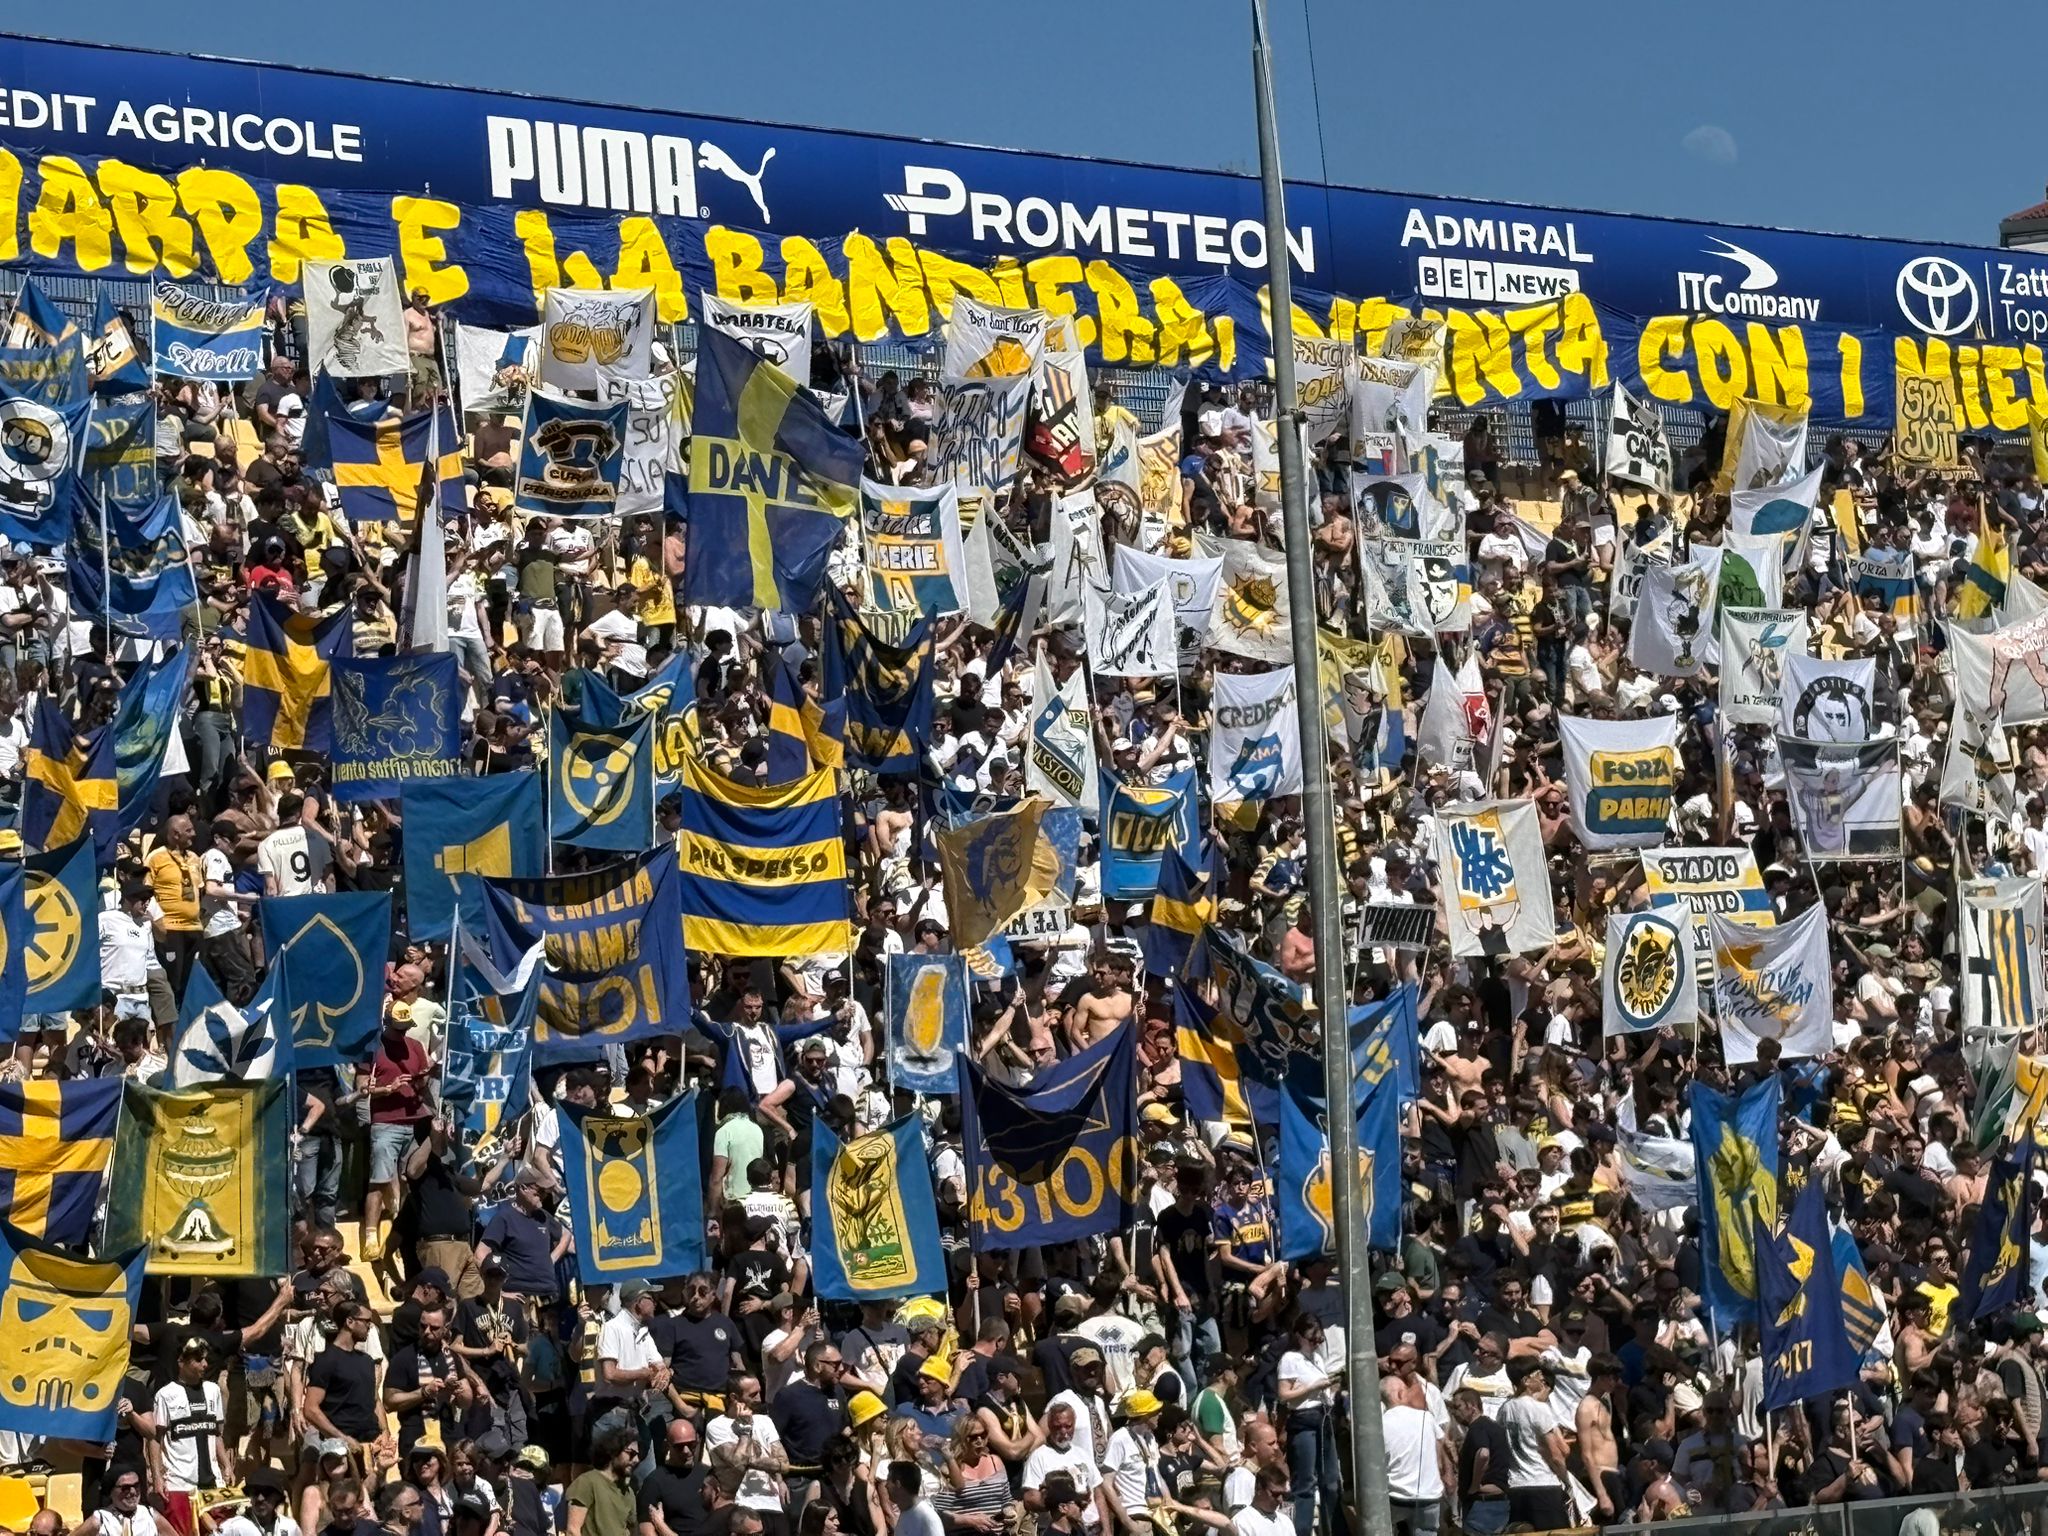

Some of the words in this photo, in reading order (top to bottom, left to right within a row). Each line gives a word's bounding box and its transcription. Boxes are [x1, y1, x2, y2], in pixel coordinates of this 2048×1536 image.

[107, 101, 362, 163] AGRICOLE
[487, 115, 699, 219] PUMA
[884, 165, 1314, 272] PROMETEON
[1401, 208, 1593, 263] ADMIRAL
[393, 196, 470, 307] E
[515, 209, 688, 325] LA
[1638, 315, 1810, 410] CON
[1840, 333, 1864, 418] I
[880, 545, 938, 570] SERIE
[1603, 758, 1670, 783] FORZA
[290, 850, 312, 883] 9
[731, 853, 830, 879] SPESSO
[1658, 855, 1740, 883] STADIO
[533, 963, 662, 1043] NOI
